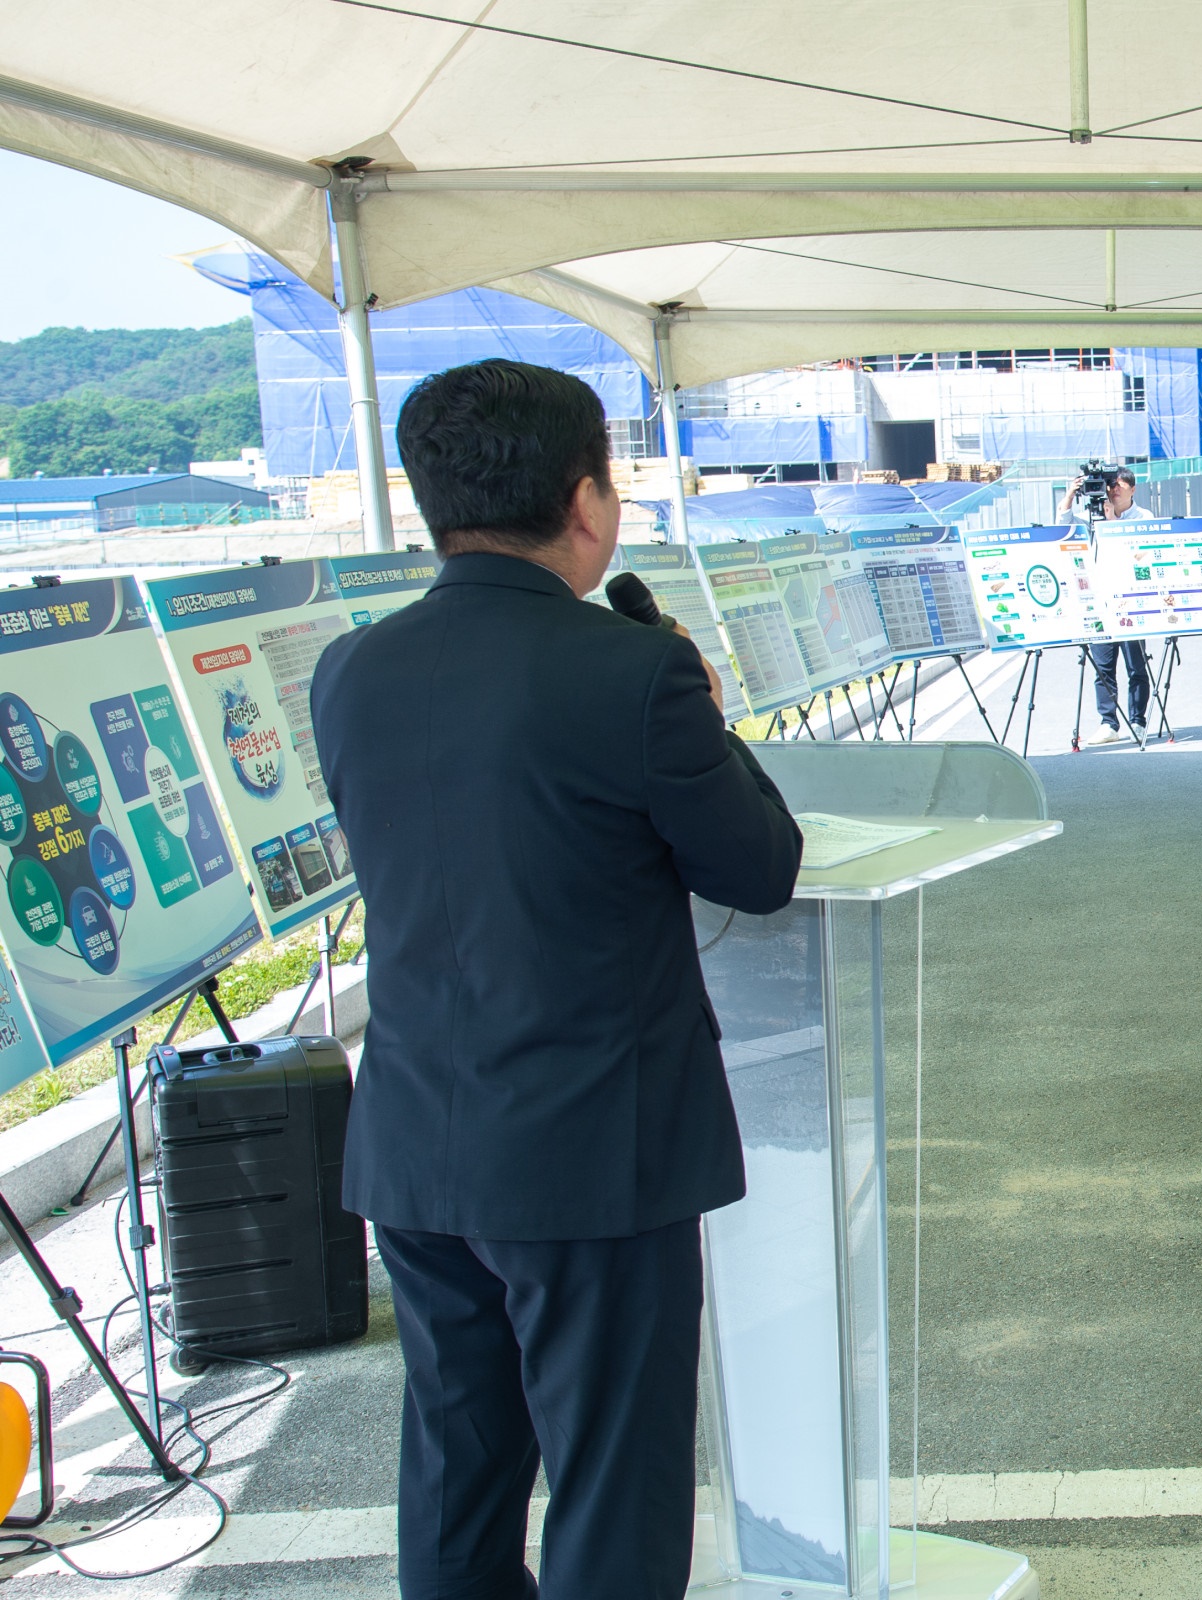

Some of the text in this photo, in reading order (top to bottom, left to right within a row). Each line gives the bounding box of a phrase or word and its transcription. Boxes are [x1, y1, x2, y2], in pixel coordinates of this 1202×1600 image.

[235, 587, 258, 603] 당위성)
[0, 609, 33, 636] 표준화
[27, 606, 53, 630] 허브
[198, 648, 246, 670] 제천입지의 당위성
[226, 701, 263, 729] 제천의
[226, 726, 282, 762] 천연물산업
[253, 759, 279, 787] 육성
[1, 818, 15, 832] 조성
[31, 802, 72, 833] 충북 제천
[36, 819, 86, 863] 강점 6가지
[24, 899, 55, 923] 천연물 관련
[29, 918, 43, 934] 기업
